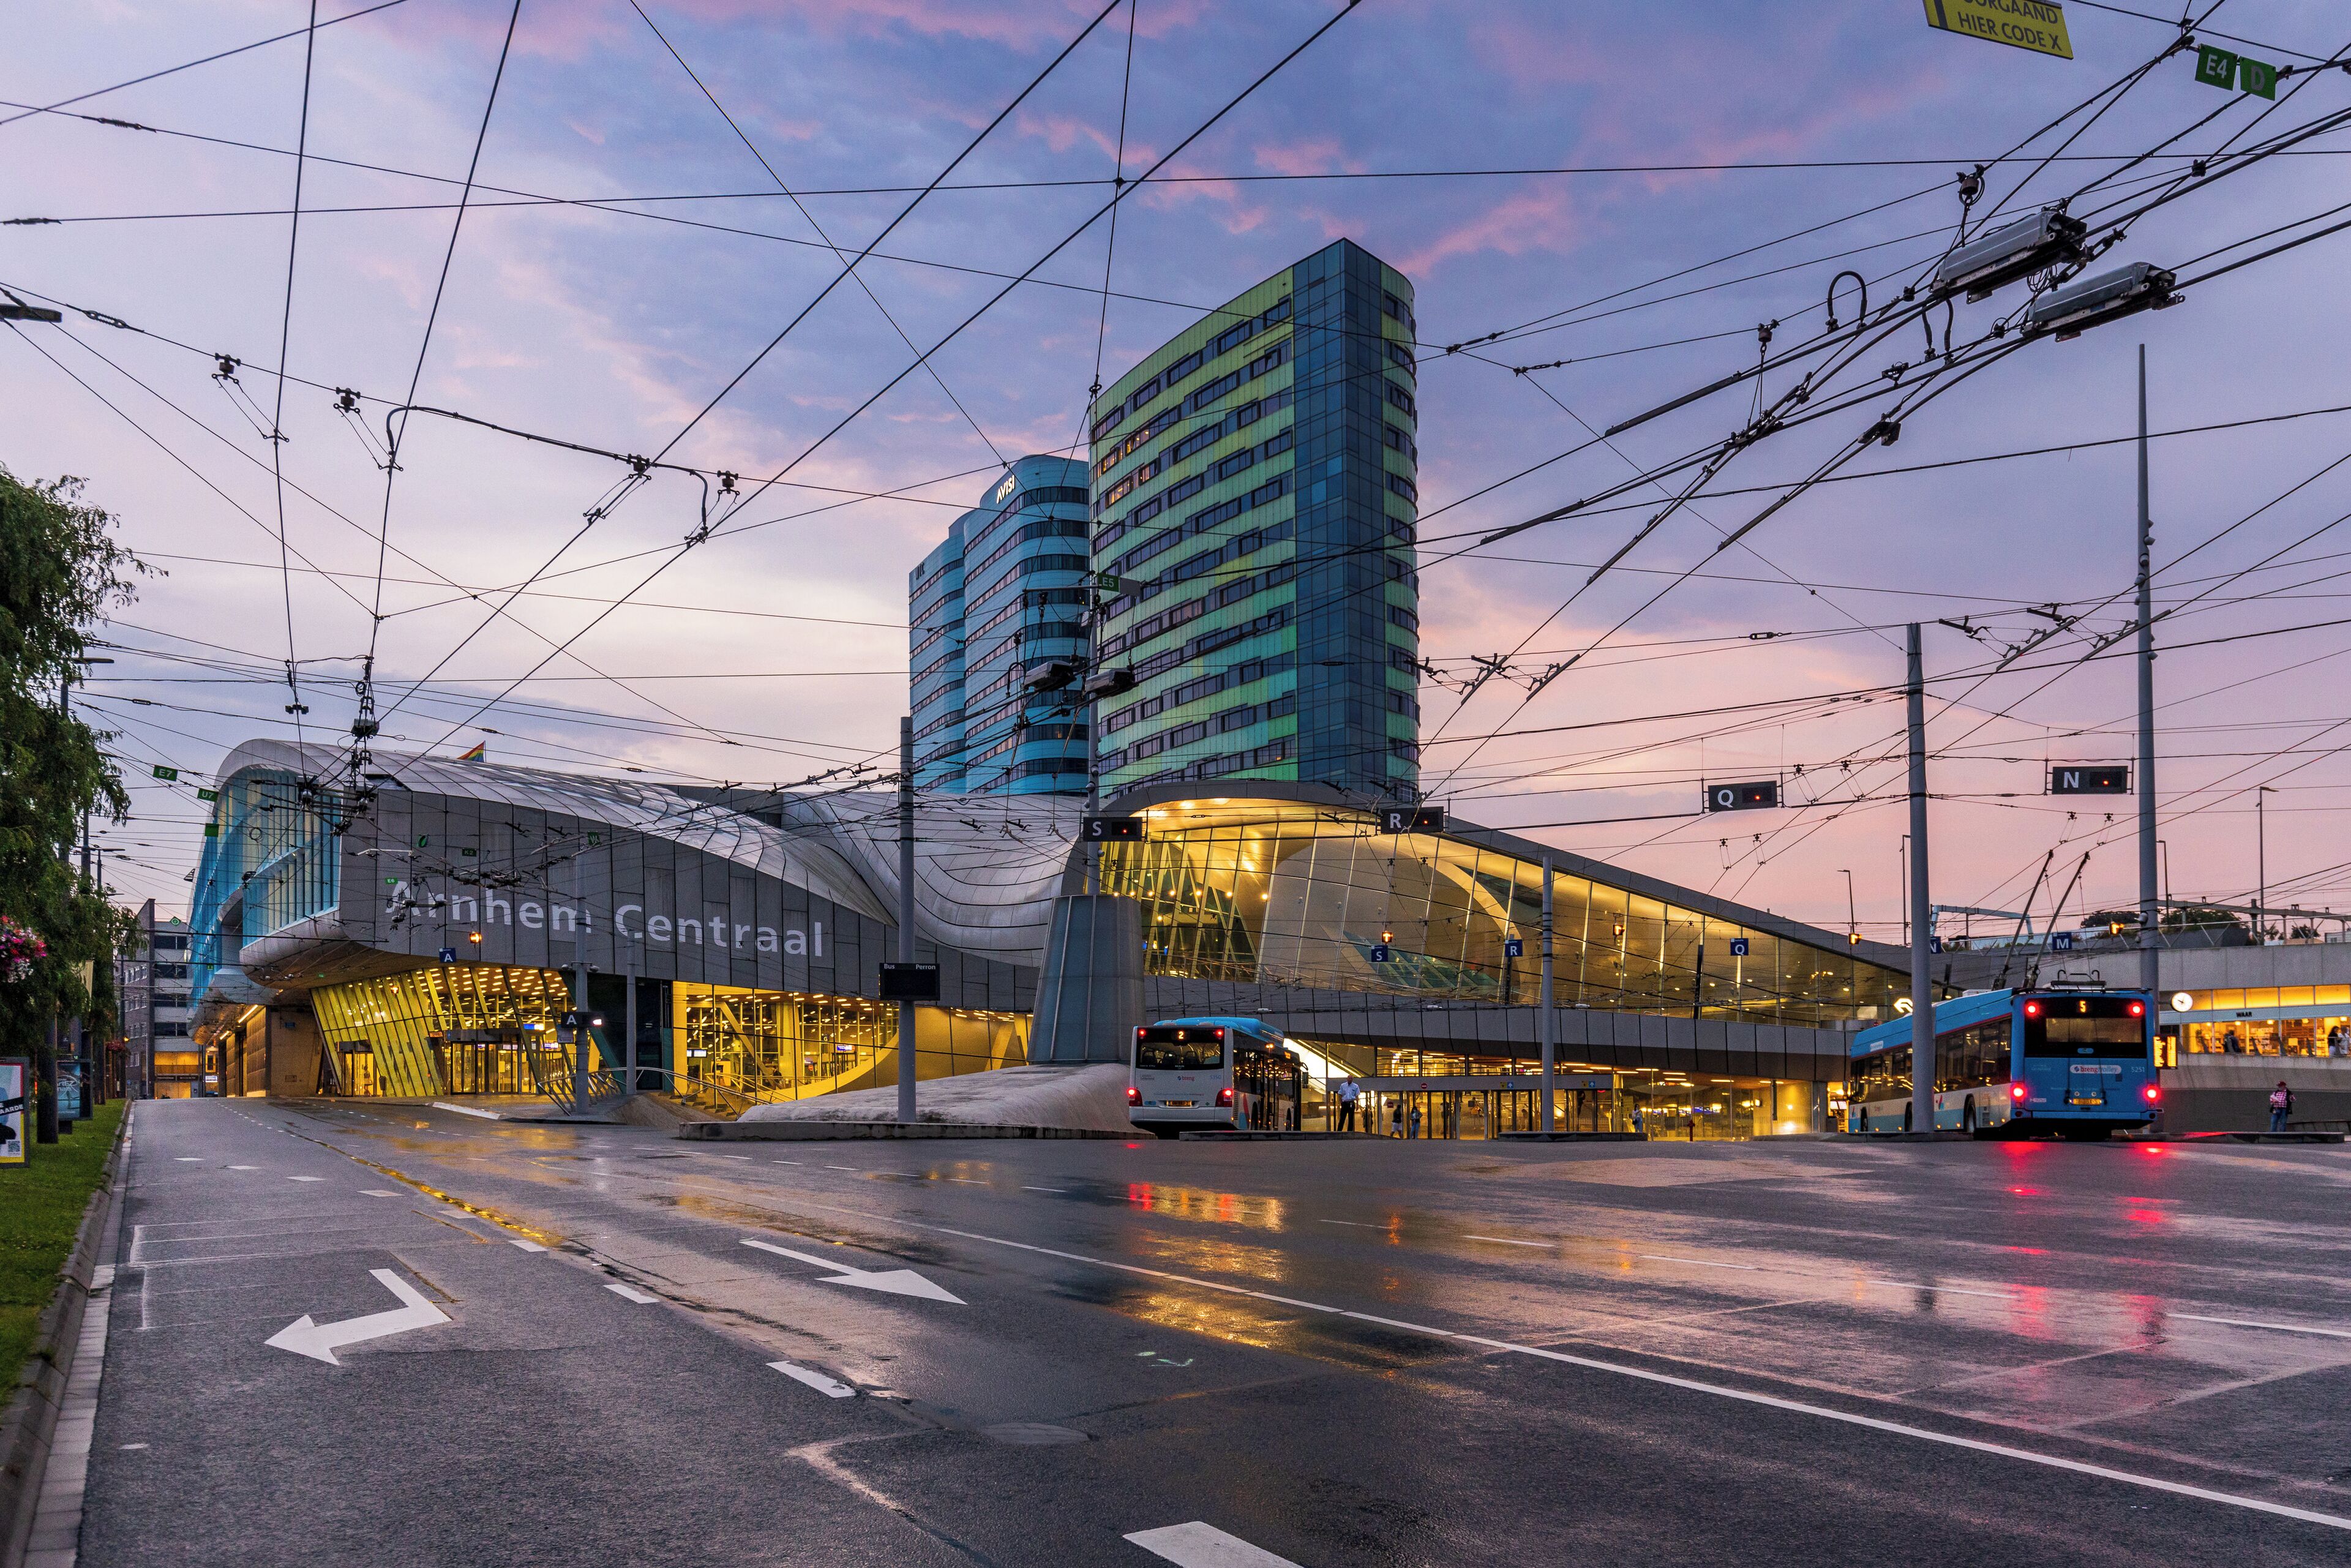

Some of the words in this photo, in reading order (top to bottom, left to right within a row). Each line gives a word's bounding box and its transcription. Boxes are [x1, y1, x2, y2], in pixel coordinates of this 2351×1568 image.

[1963, 0, 2058, 24] RGAAND
[1957, 11, 1998, 36] HIER
[2001, 23, 2046, 48] CODE
[2049, 33, 2063, 51] X
[2205, 54, 2227, 79] E4
[2251, 66, 2265, 91] D
[996, 475, 1014, 504] AVISI
[1102, 577, 1114, 588] E5
[159, 768, 173, 778] E7
[2063, 771, 2080, 789] N
[1717, 789, 1734, 808] Q
[1390, 812, 1402, 828] R
[1092, 821, 1102, 836] S
[385, 880, 592, 934] Arnhem
[615, 904, 823, 957] Centraal
[1510, 945, 1518, 956] R
[1734, 944, 1745, 956] Q
[2057, 938, 2069, 949] M
[444, 953, 453, 962] A
[1376, 951, 1382, 961] S
[2079, 1000, 2087, 1013] 5
[566, 1015, 577, 1025] A
[1179, 1031, 1185, 1040] 2
